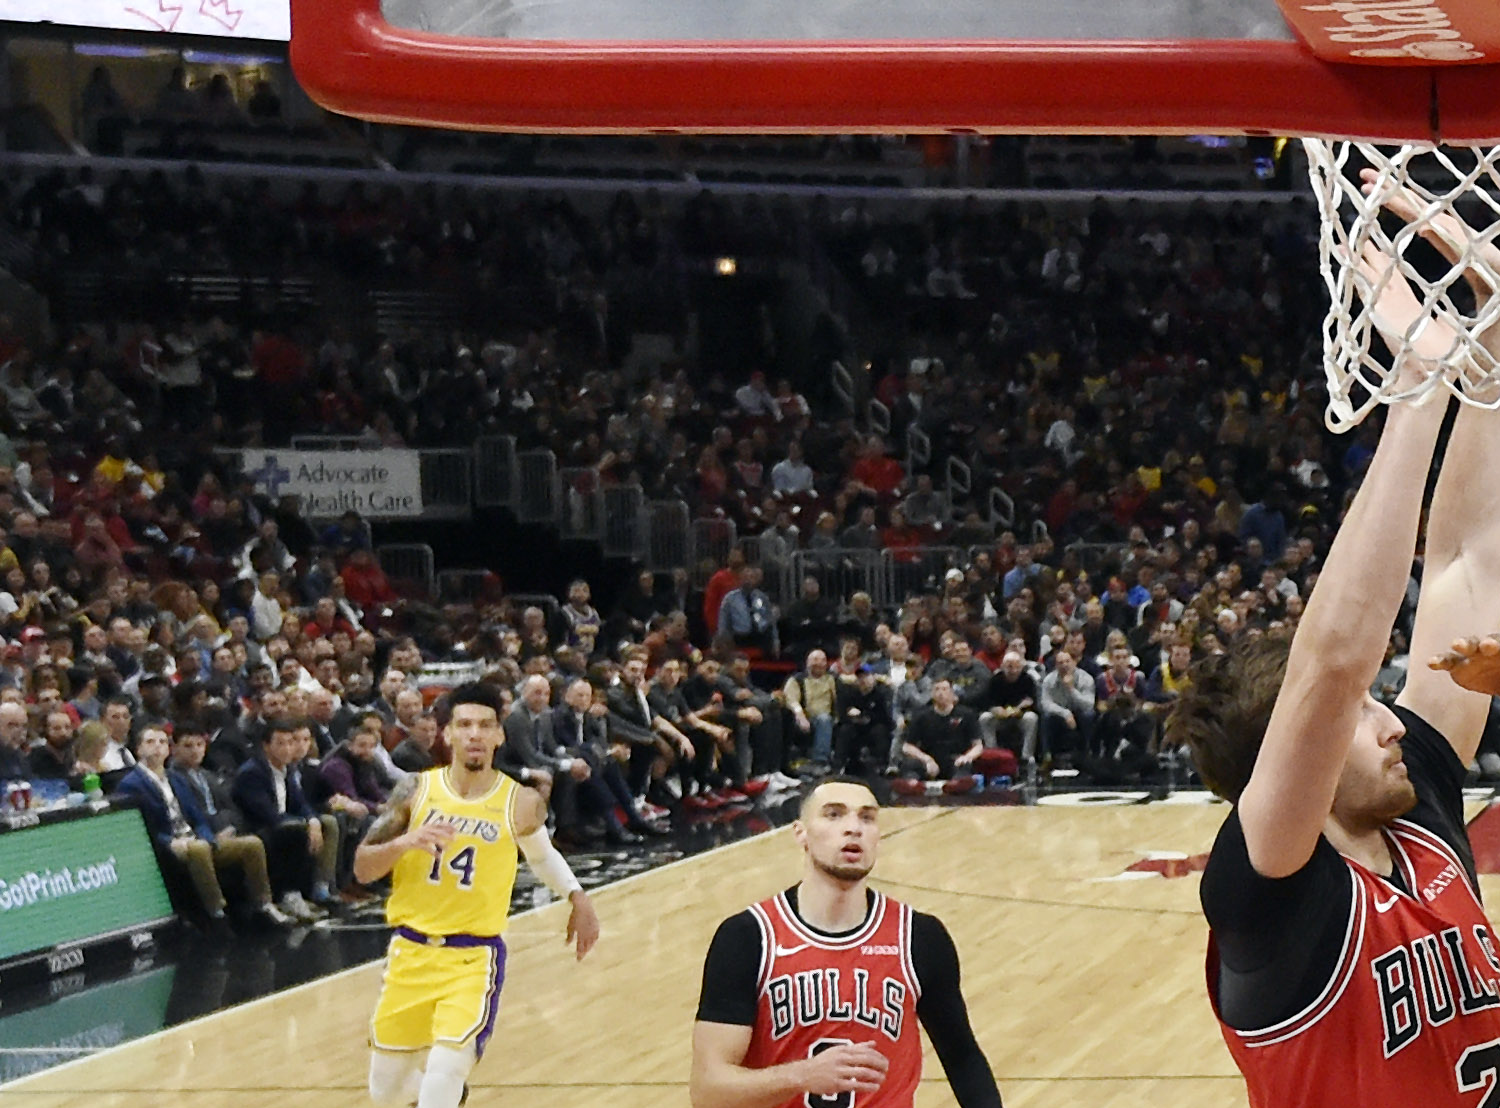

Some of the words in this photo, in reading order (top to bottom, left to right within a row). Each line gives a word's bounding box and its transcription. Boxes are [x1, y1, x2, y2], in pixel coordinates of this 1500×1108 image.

[297, 459, 390, 485] Advocate
[369, 491, 414, 512] Care
[426, 843, 478, 888] 14
[767, 968, 906, 1042] BULLS
